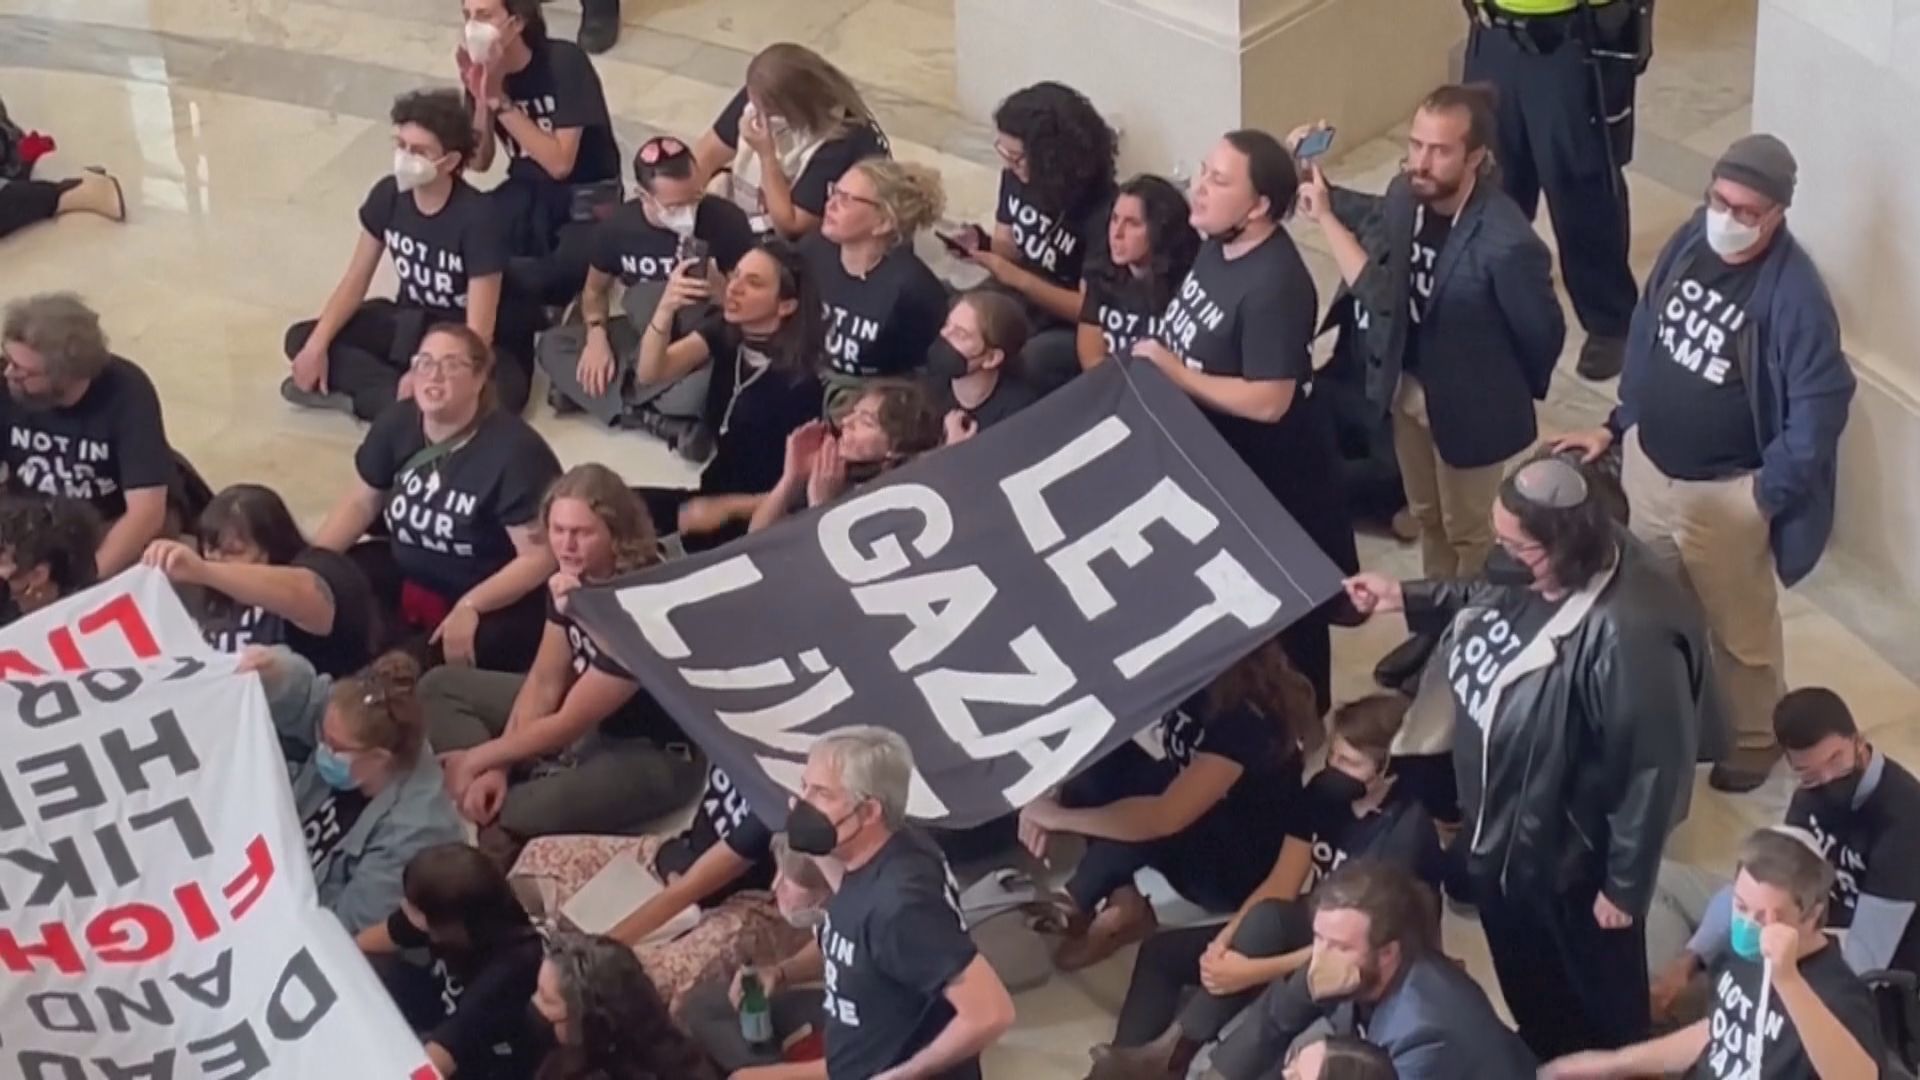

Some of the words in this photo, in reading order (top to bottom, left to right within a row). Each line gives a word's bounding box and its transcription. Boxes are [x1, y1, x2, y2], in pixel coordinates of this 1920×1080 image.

[384, 228, 428, 262] NOT
[438, 248, 464, 273] IN
[1012, 222, 1057, 272] OUR
[1053, 227, 1077, 256] IN
[395, 255, 455, 294] OUR
[621, 254, 674, 276] NOT
[1197, 300, 1225, 332] IN
[1674, 279, 1723, 313] OT
[851, 315, 879, 341] IN
[1164, 297, 1198, 351] OUR
[1666, 296, 1726, 354] OUR
[824, 332, 860, 363] UR
[1659, 324, 1732, 385] AME
[10, 425, 70, 454] NOT
[78, 437, 109, 462] IN
[390, 494, 454, 540] OUR
[445, 489, 477, 516] IN
[1000, 414, 1283, 680] LET
[817, 482, 1117, 809] GAZA
[1464, 635, 1500, 685] OU
[0, 796, 215, 912] LIK
[1312, 831, 1348, 872] OT
[829, 931, 855, 967] IN
[26, 946, 234, 1034] AND
[1717, 969, 1753, 1022] NOT
